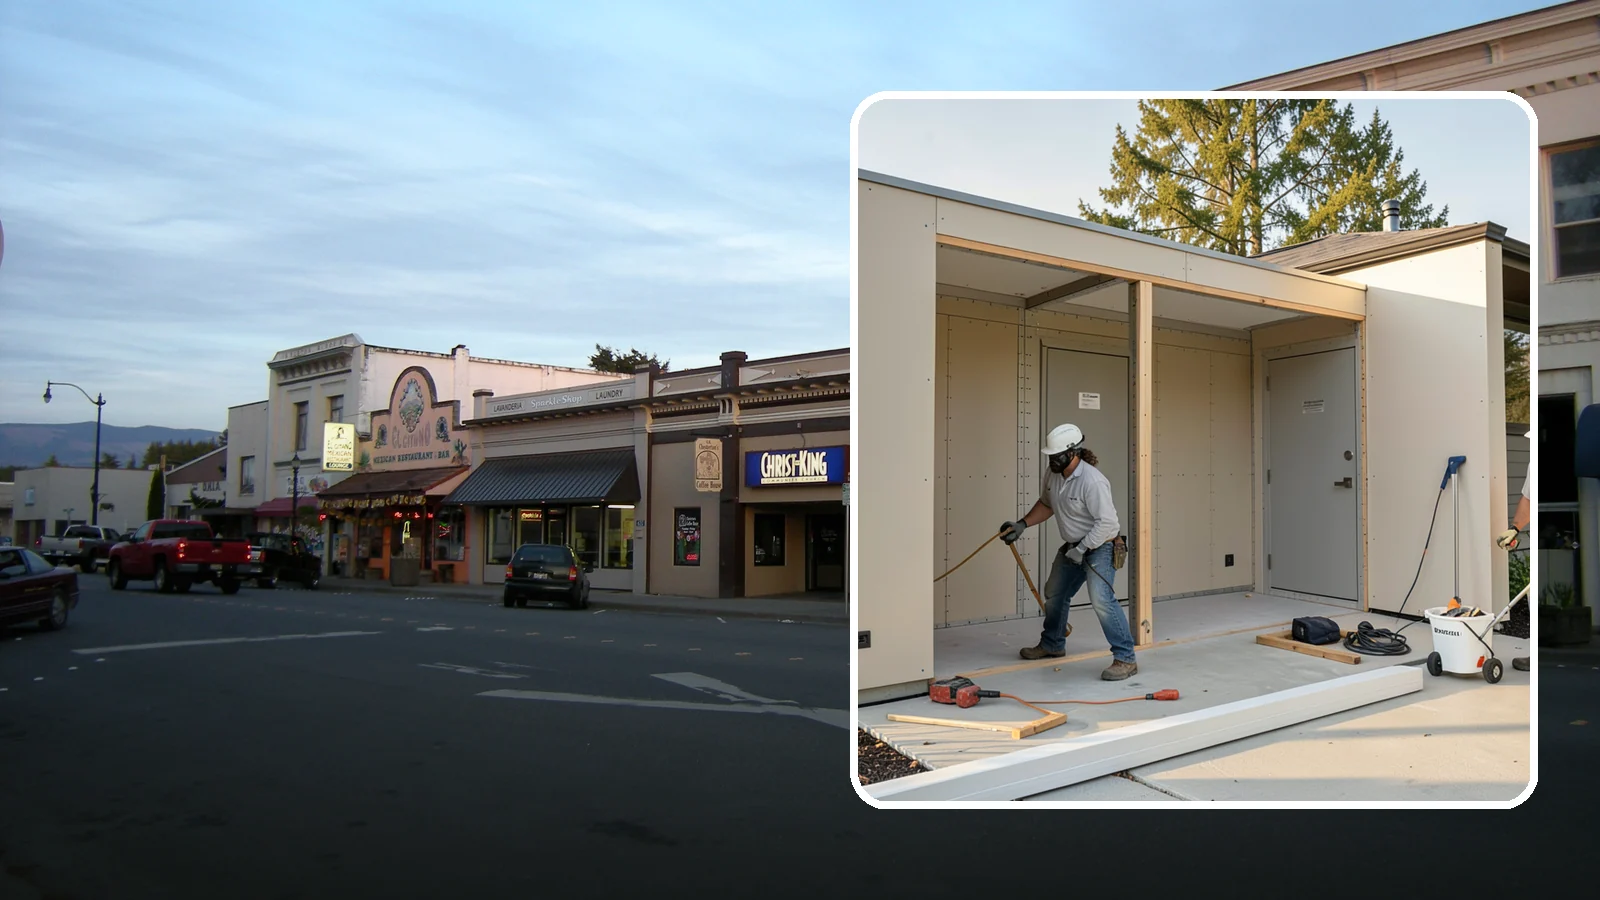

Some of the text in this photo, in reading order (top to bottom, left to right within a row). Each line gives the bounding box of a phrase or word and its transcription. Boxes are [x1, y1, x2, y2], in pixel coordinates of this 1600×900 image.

[530, 394, 583, 409] Sparkle Shop
[595, 389, 623, 400] LAUNDRY
[493, 402, 522, 413] LAVANDERIA
[373, 450, 450, 464] MEXICAN RESTAURANT BAR
[761, 450, 827, 478] CHRIST KING
